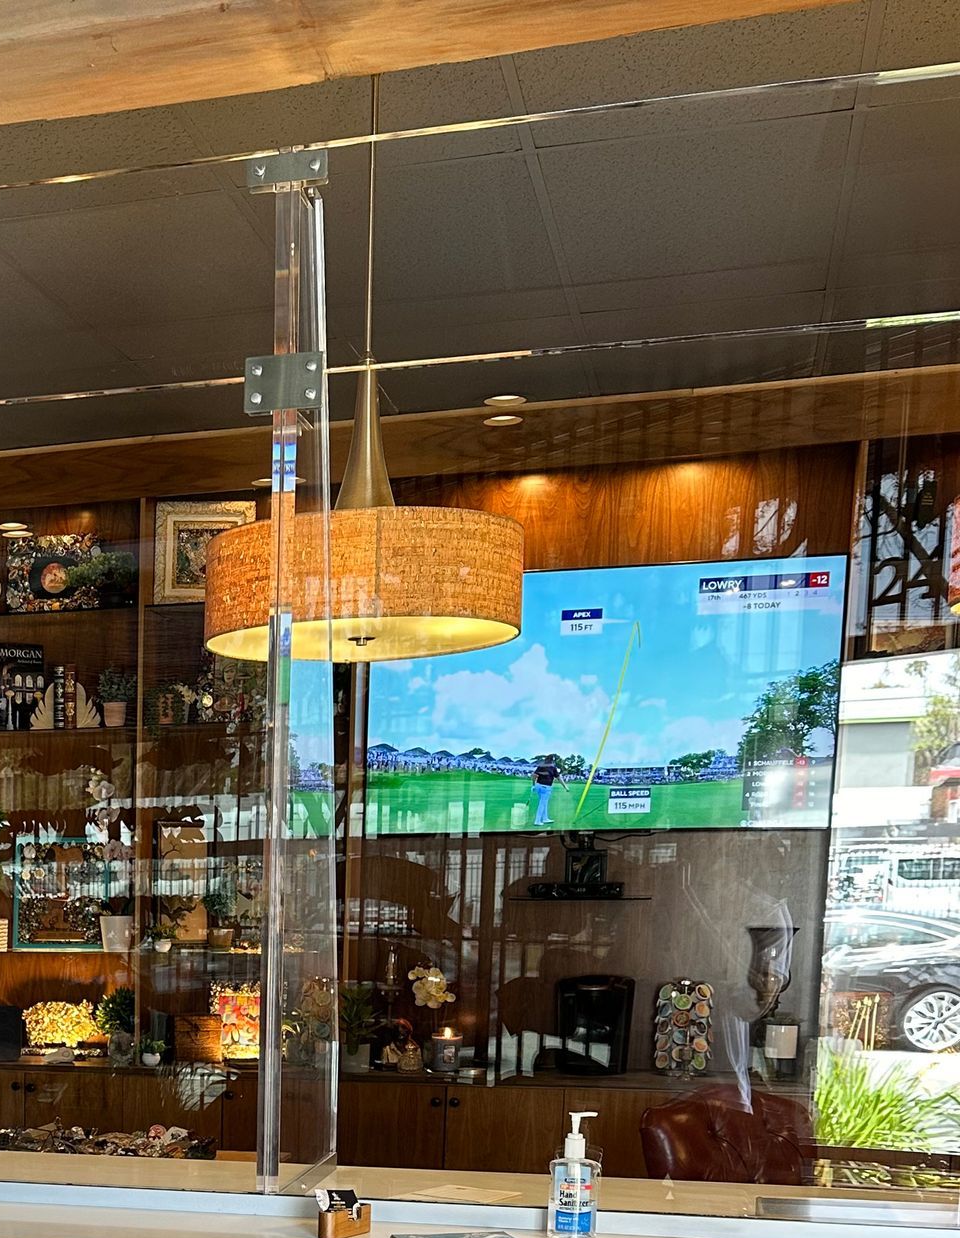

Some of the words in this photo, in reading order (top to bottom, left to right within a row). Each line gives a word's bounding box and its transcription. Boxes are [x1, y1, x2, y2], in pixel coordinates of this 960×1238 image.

[702, 579, 742, 591] LOWRY
[811, 575, 828, 585] -12
[754, 601, 781, 609] TODAY
[573, 610, 591, 618] APEX
[570, 623, 583, 632] 115
[0, 648, 42, 658] MORGAN
[560, 1190, 577, 1198] Hand
